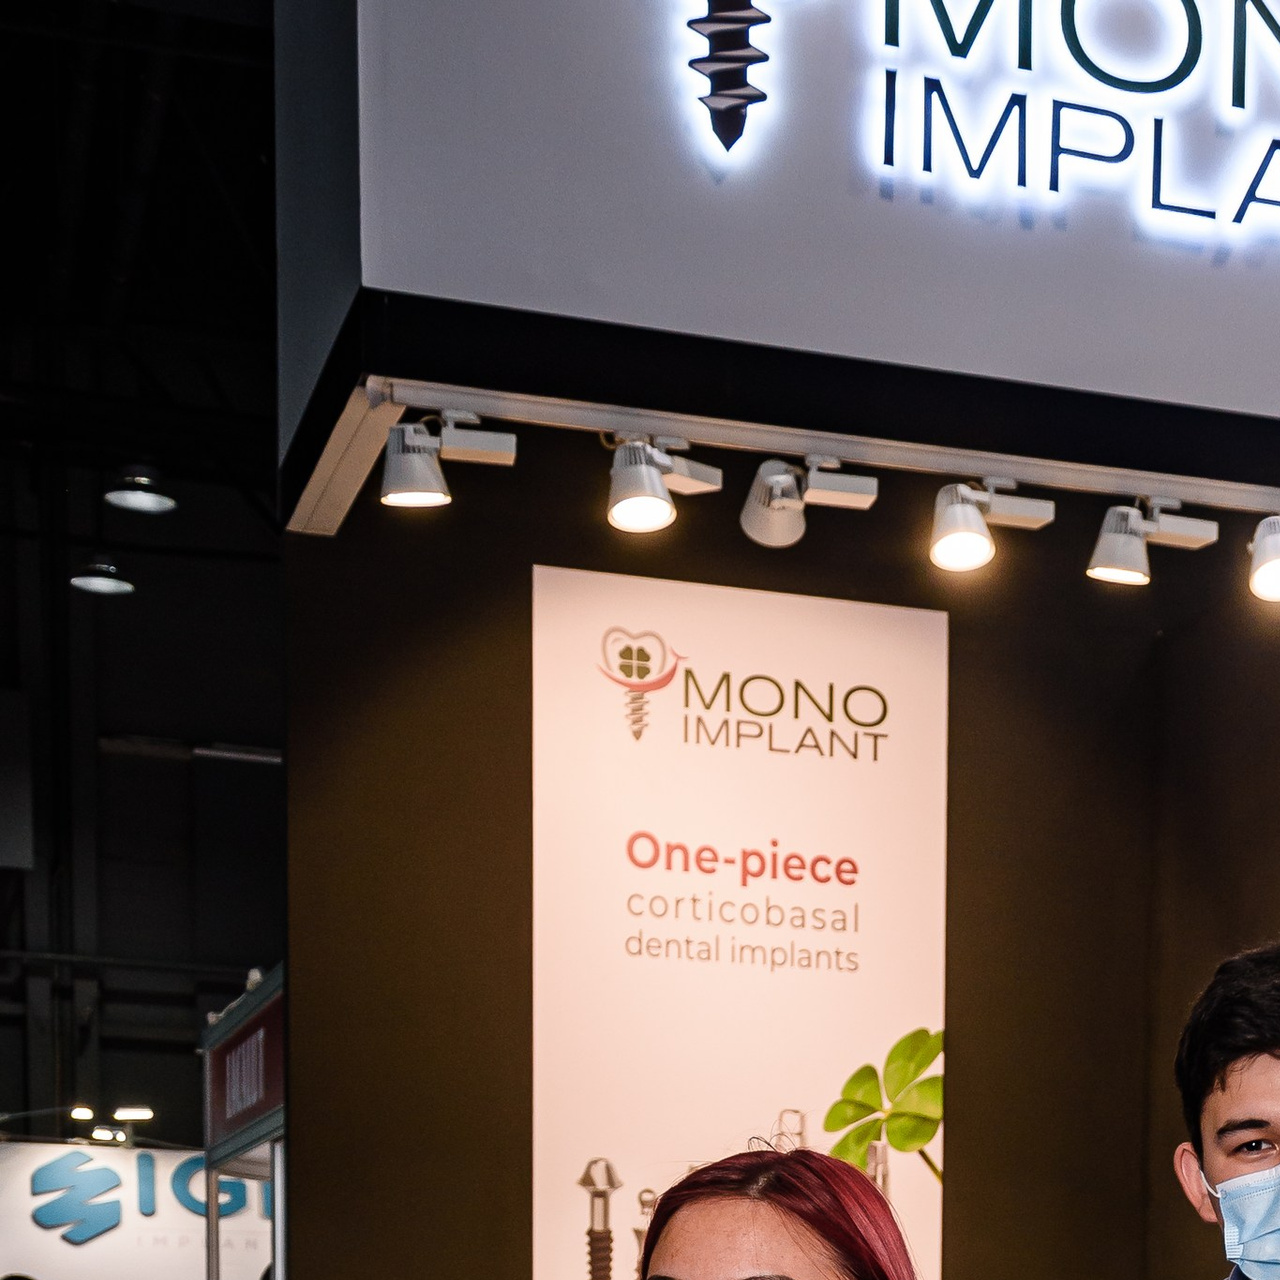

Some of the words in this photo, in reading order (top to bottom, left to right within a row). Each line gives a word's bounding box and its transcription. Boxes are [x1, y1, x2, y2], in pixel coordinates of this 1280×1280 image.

[684, 668, 888, 728] MONO
[683, 714, 888, 761] IMPLANT
[626, 830, 860, 887] One-piece
[626, 891, 860, 933] corticobasal
[624, 929, 720, 962] dental
[730, 936, 860, 973] implants
[137, 1151, 271, 1219] IG
